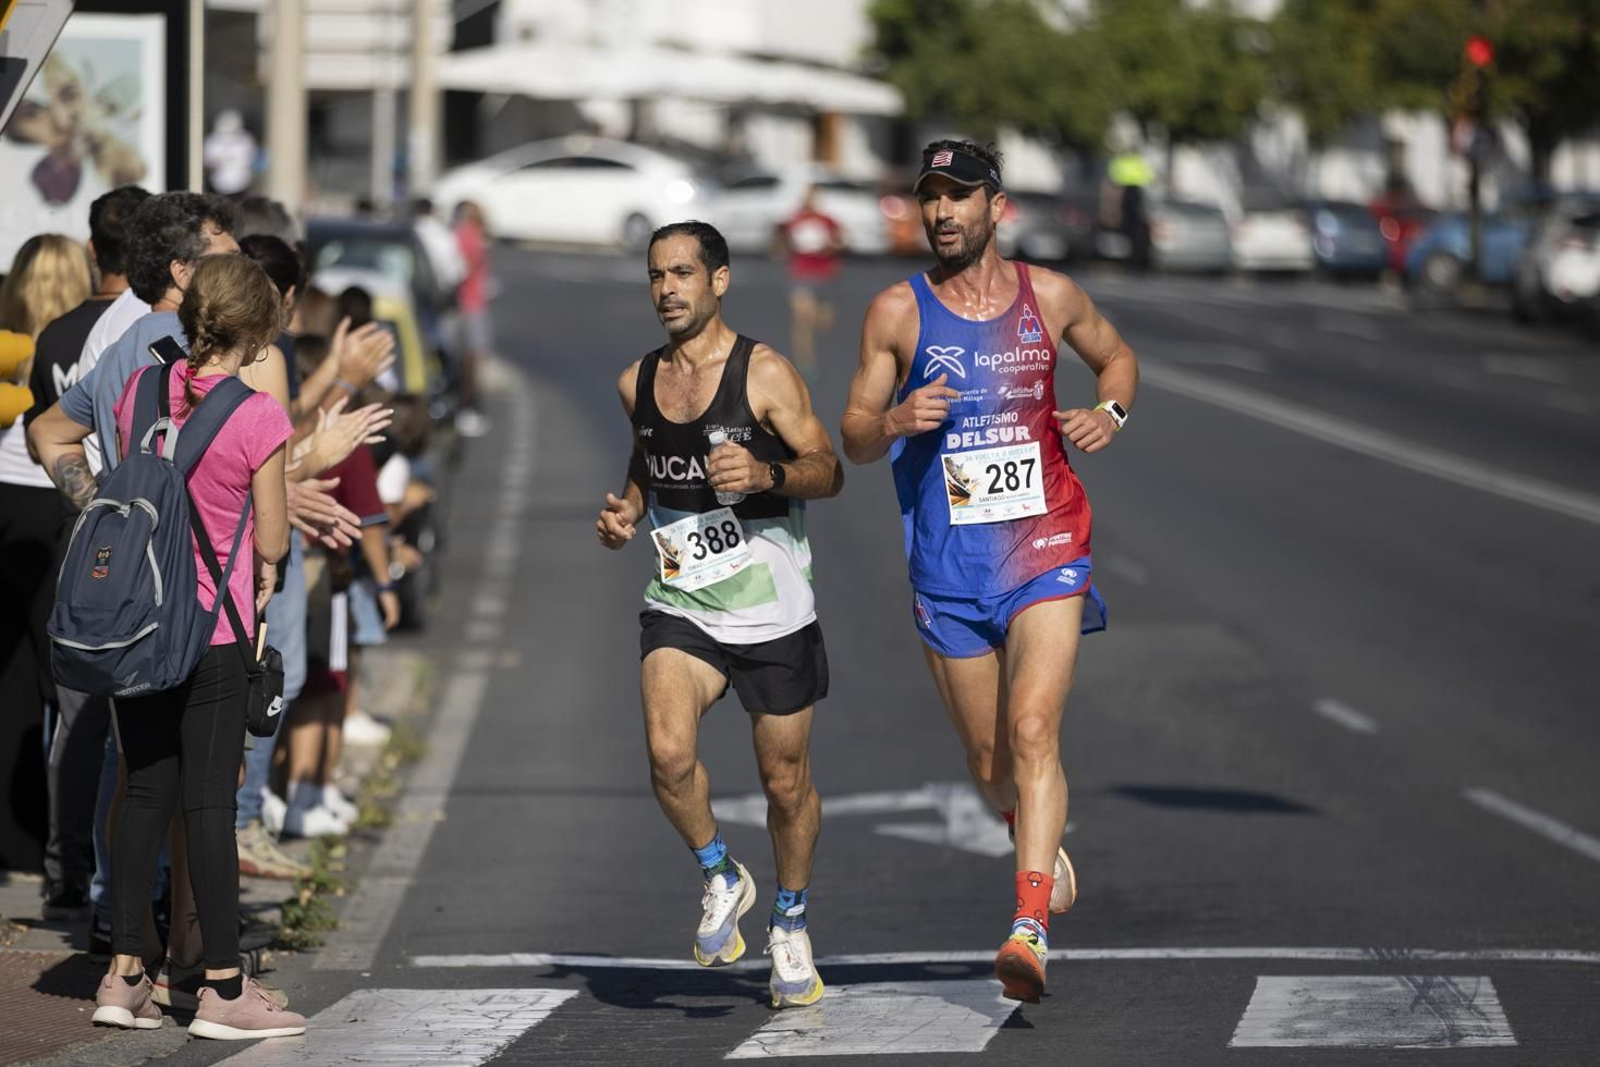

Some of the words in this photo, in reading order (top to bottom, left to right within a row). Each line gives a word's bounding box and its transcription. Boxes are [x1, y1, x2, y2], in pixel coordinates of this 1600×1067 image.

[974, 346, 1050, 371] lapalma
[962, 411, 1019, 428] ATLETISMO
[946, 425, 1031, 450] DELSUR
[985, 458, 1036, 495] 287
[687, 520, 740, 560] 388
